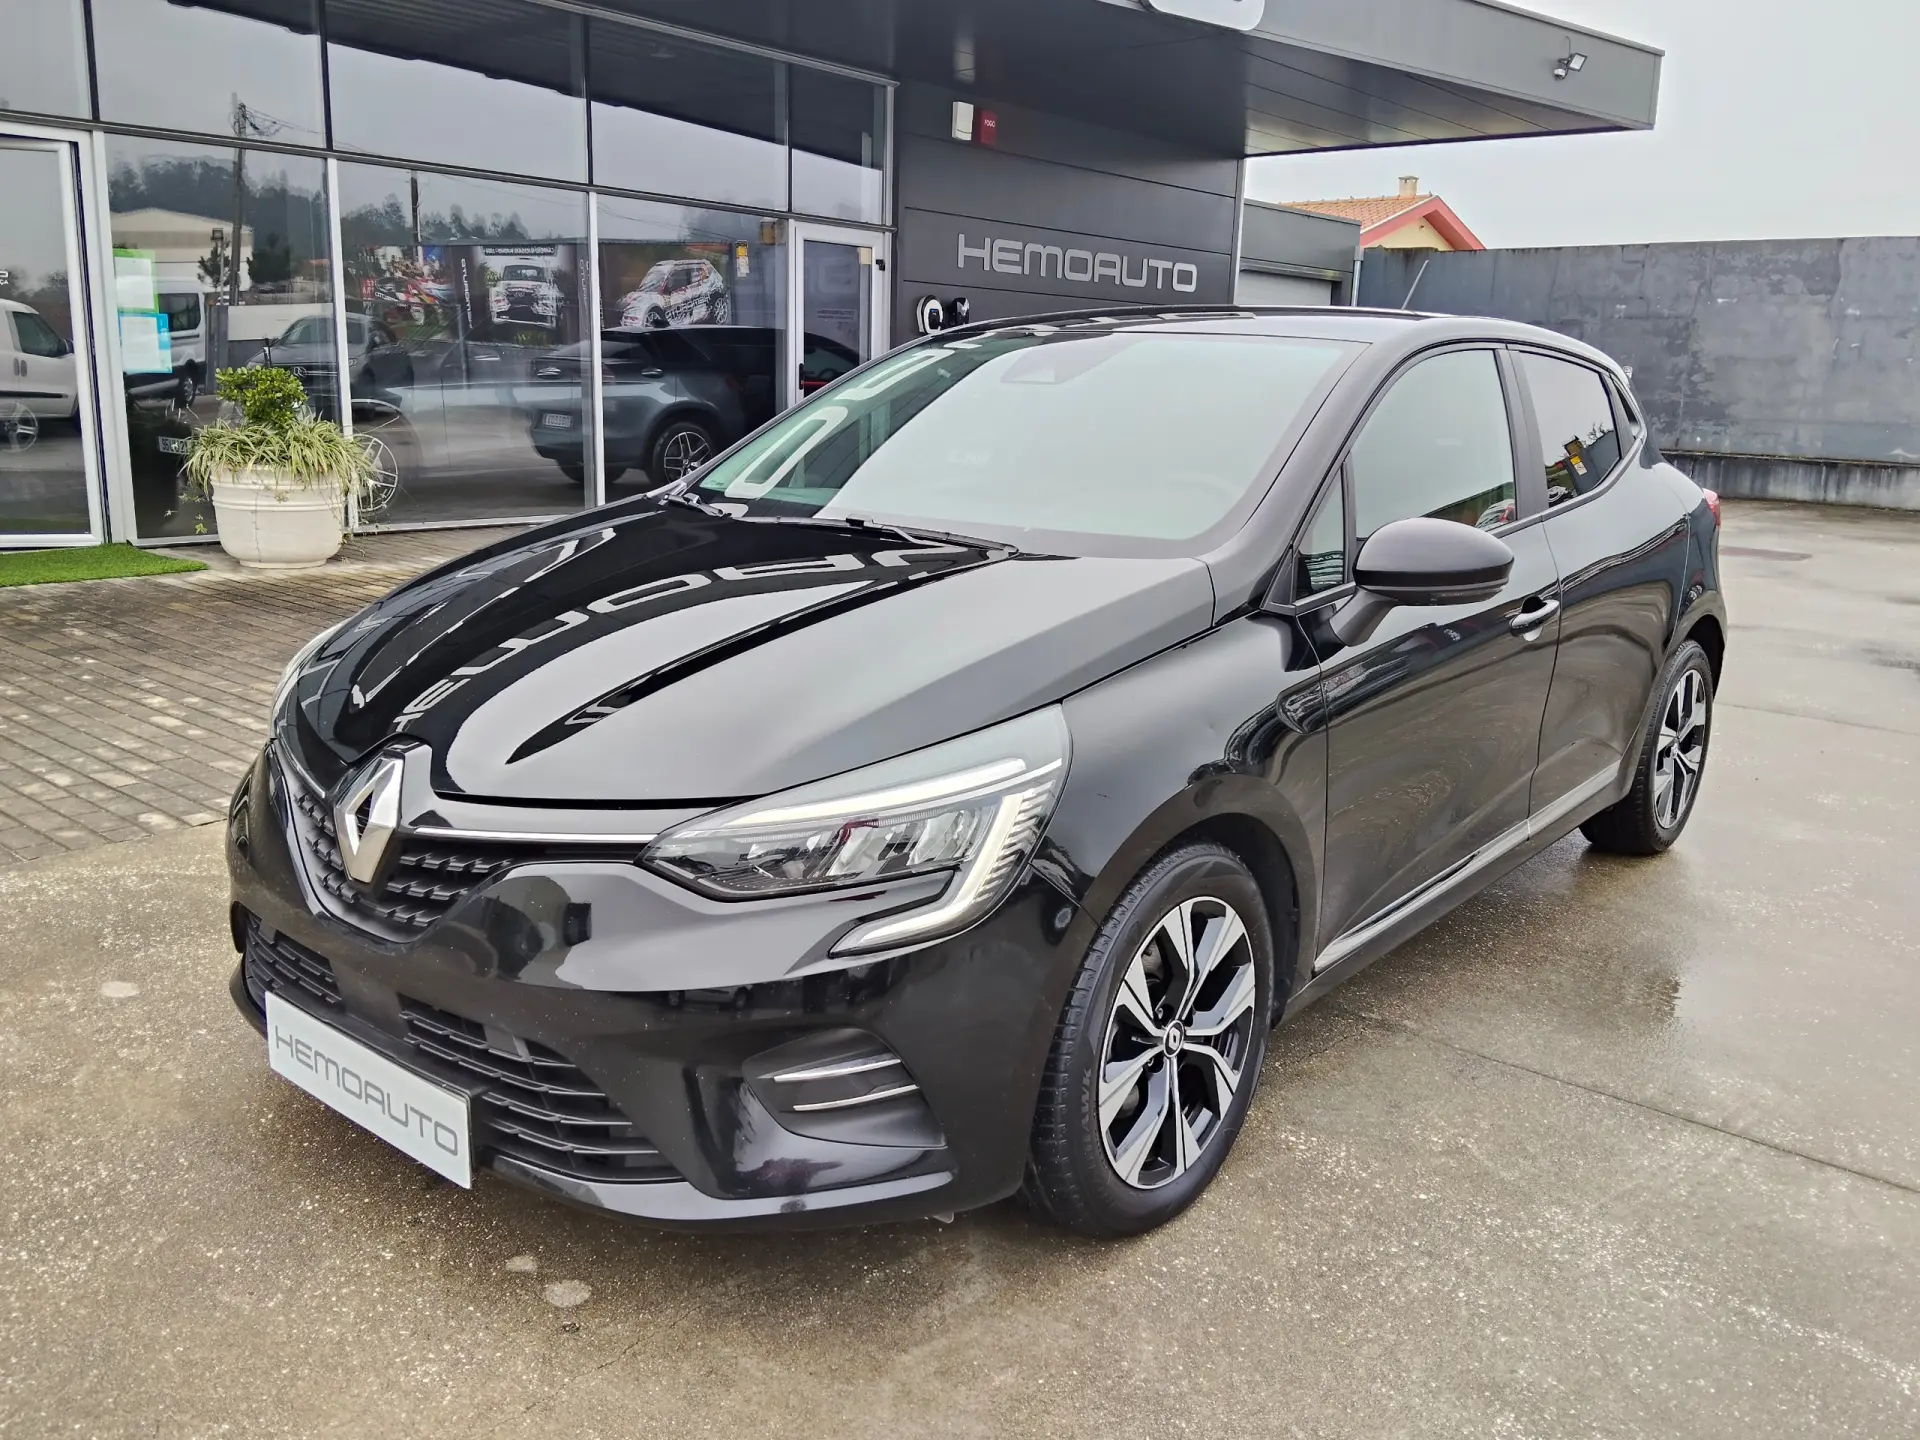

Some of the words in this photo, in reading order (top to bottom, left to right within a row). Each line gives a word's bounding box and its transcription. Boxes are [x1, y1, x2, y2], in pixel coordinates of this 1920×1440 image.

[984, 118, 996, 128] FOGO
[957, 233, 1198, 293] HEMOAUTO
[275, 1025, 459, 1157] HEMOAUTO
